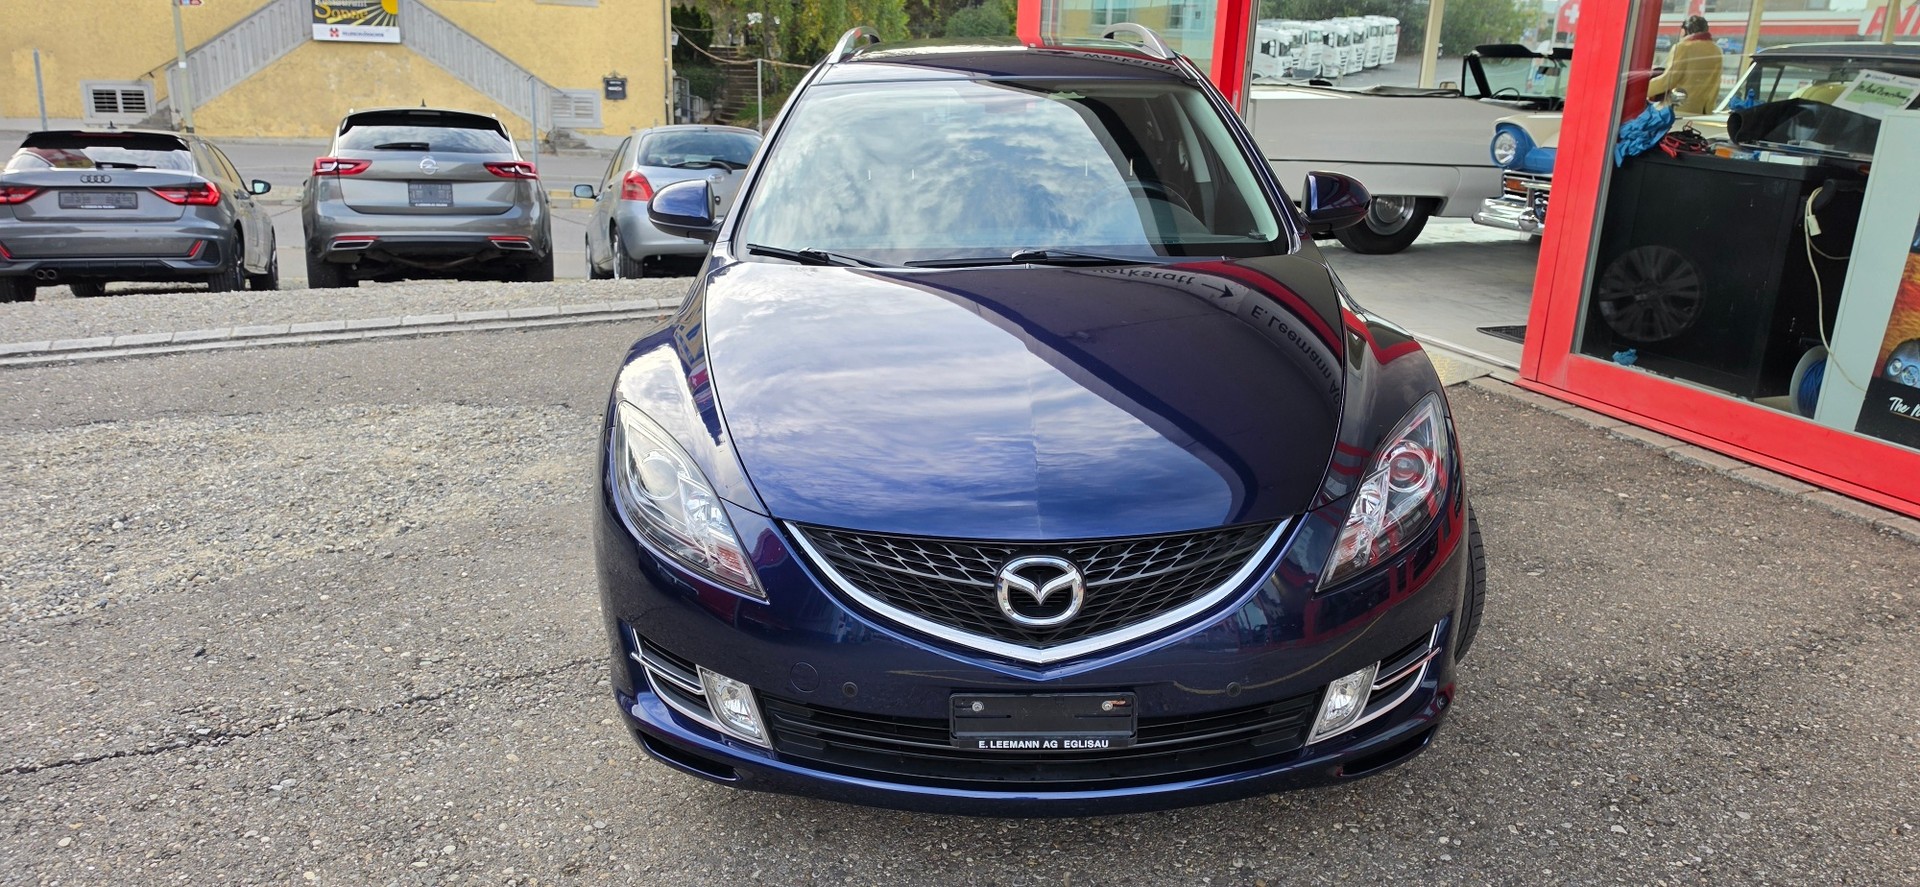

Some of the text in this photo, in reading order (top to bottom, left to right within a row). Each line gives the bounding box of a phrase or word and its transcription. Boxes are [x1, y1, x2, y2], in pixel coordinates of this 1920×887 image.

[1889, 397, 1911, 413] The
[990, 740, 1039, 749] LEEMANN
[1043, 740, 1058, 749] AG
[1064, 740, 1109, 748] EGLISAU
